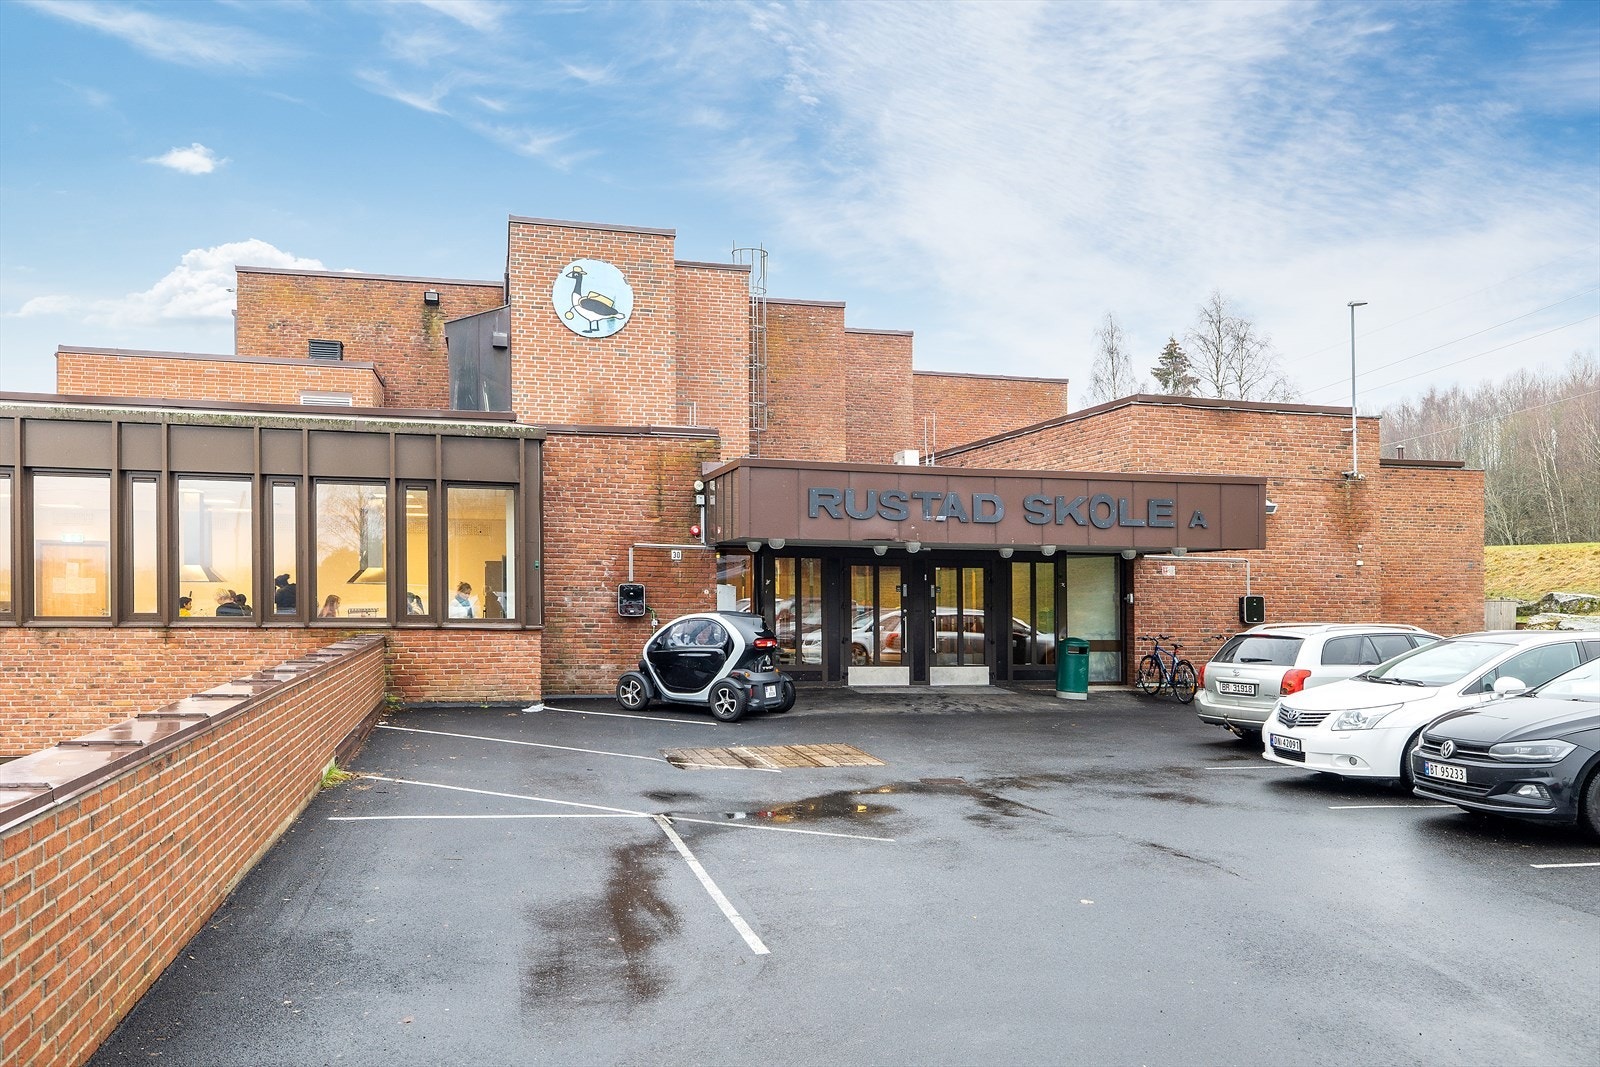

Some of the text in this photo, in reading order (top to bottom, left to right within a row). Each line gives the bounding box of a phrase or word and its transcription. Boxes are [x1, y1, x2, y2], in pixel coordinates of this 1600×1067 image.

[808, 486, 1209, 530] RUSTAD SKOLE A
[672, 551, 681, 559] 30
[1232, 684, 1253, 693] 31918
[1282, 738, 1299, 750] 42091
[1430, 764, 1464, 780] BT 95233
